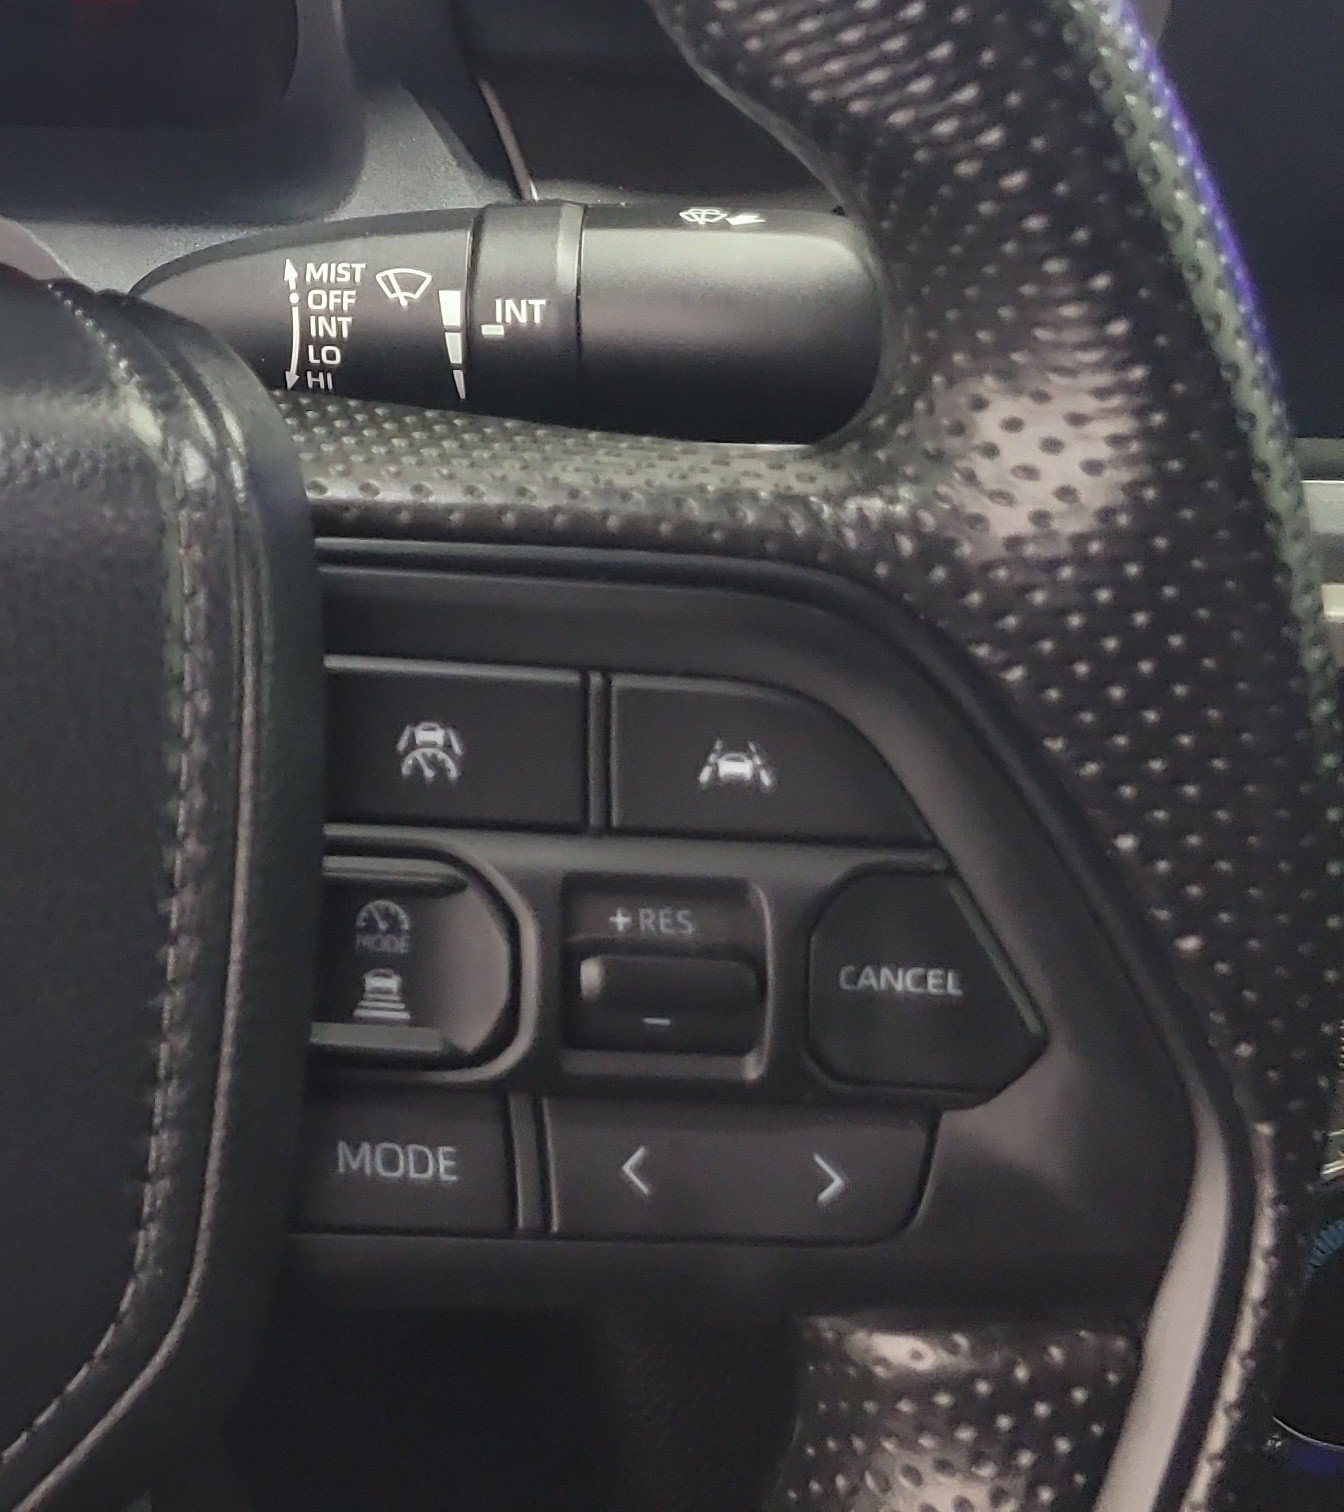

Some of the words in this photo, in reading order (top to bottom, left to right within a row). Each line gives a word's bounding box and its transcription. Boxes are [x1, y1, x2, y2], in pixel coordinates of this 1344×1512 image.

[304, 262, 368, 284] MIST
[306, 289, 357, 311] OFF
[493, 299, 548, 325] INT
[308, 315, 354, 339] INT
[307, 344, 342, 366] LO
[306, 370, 333, 390] HI
[840, 966, 962, 995] CANCEL
[338, 1141, 458, 1182] MODE
